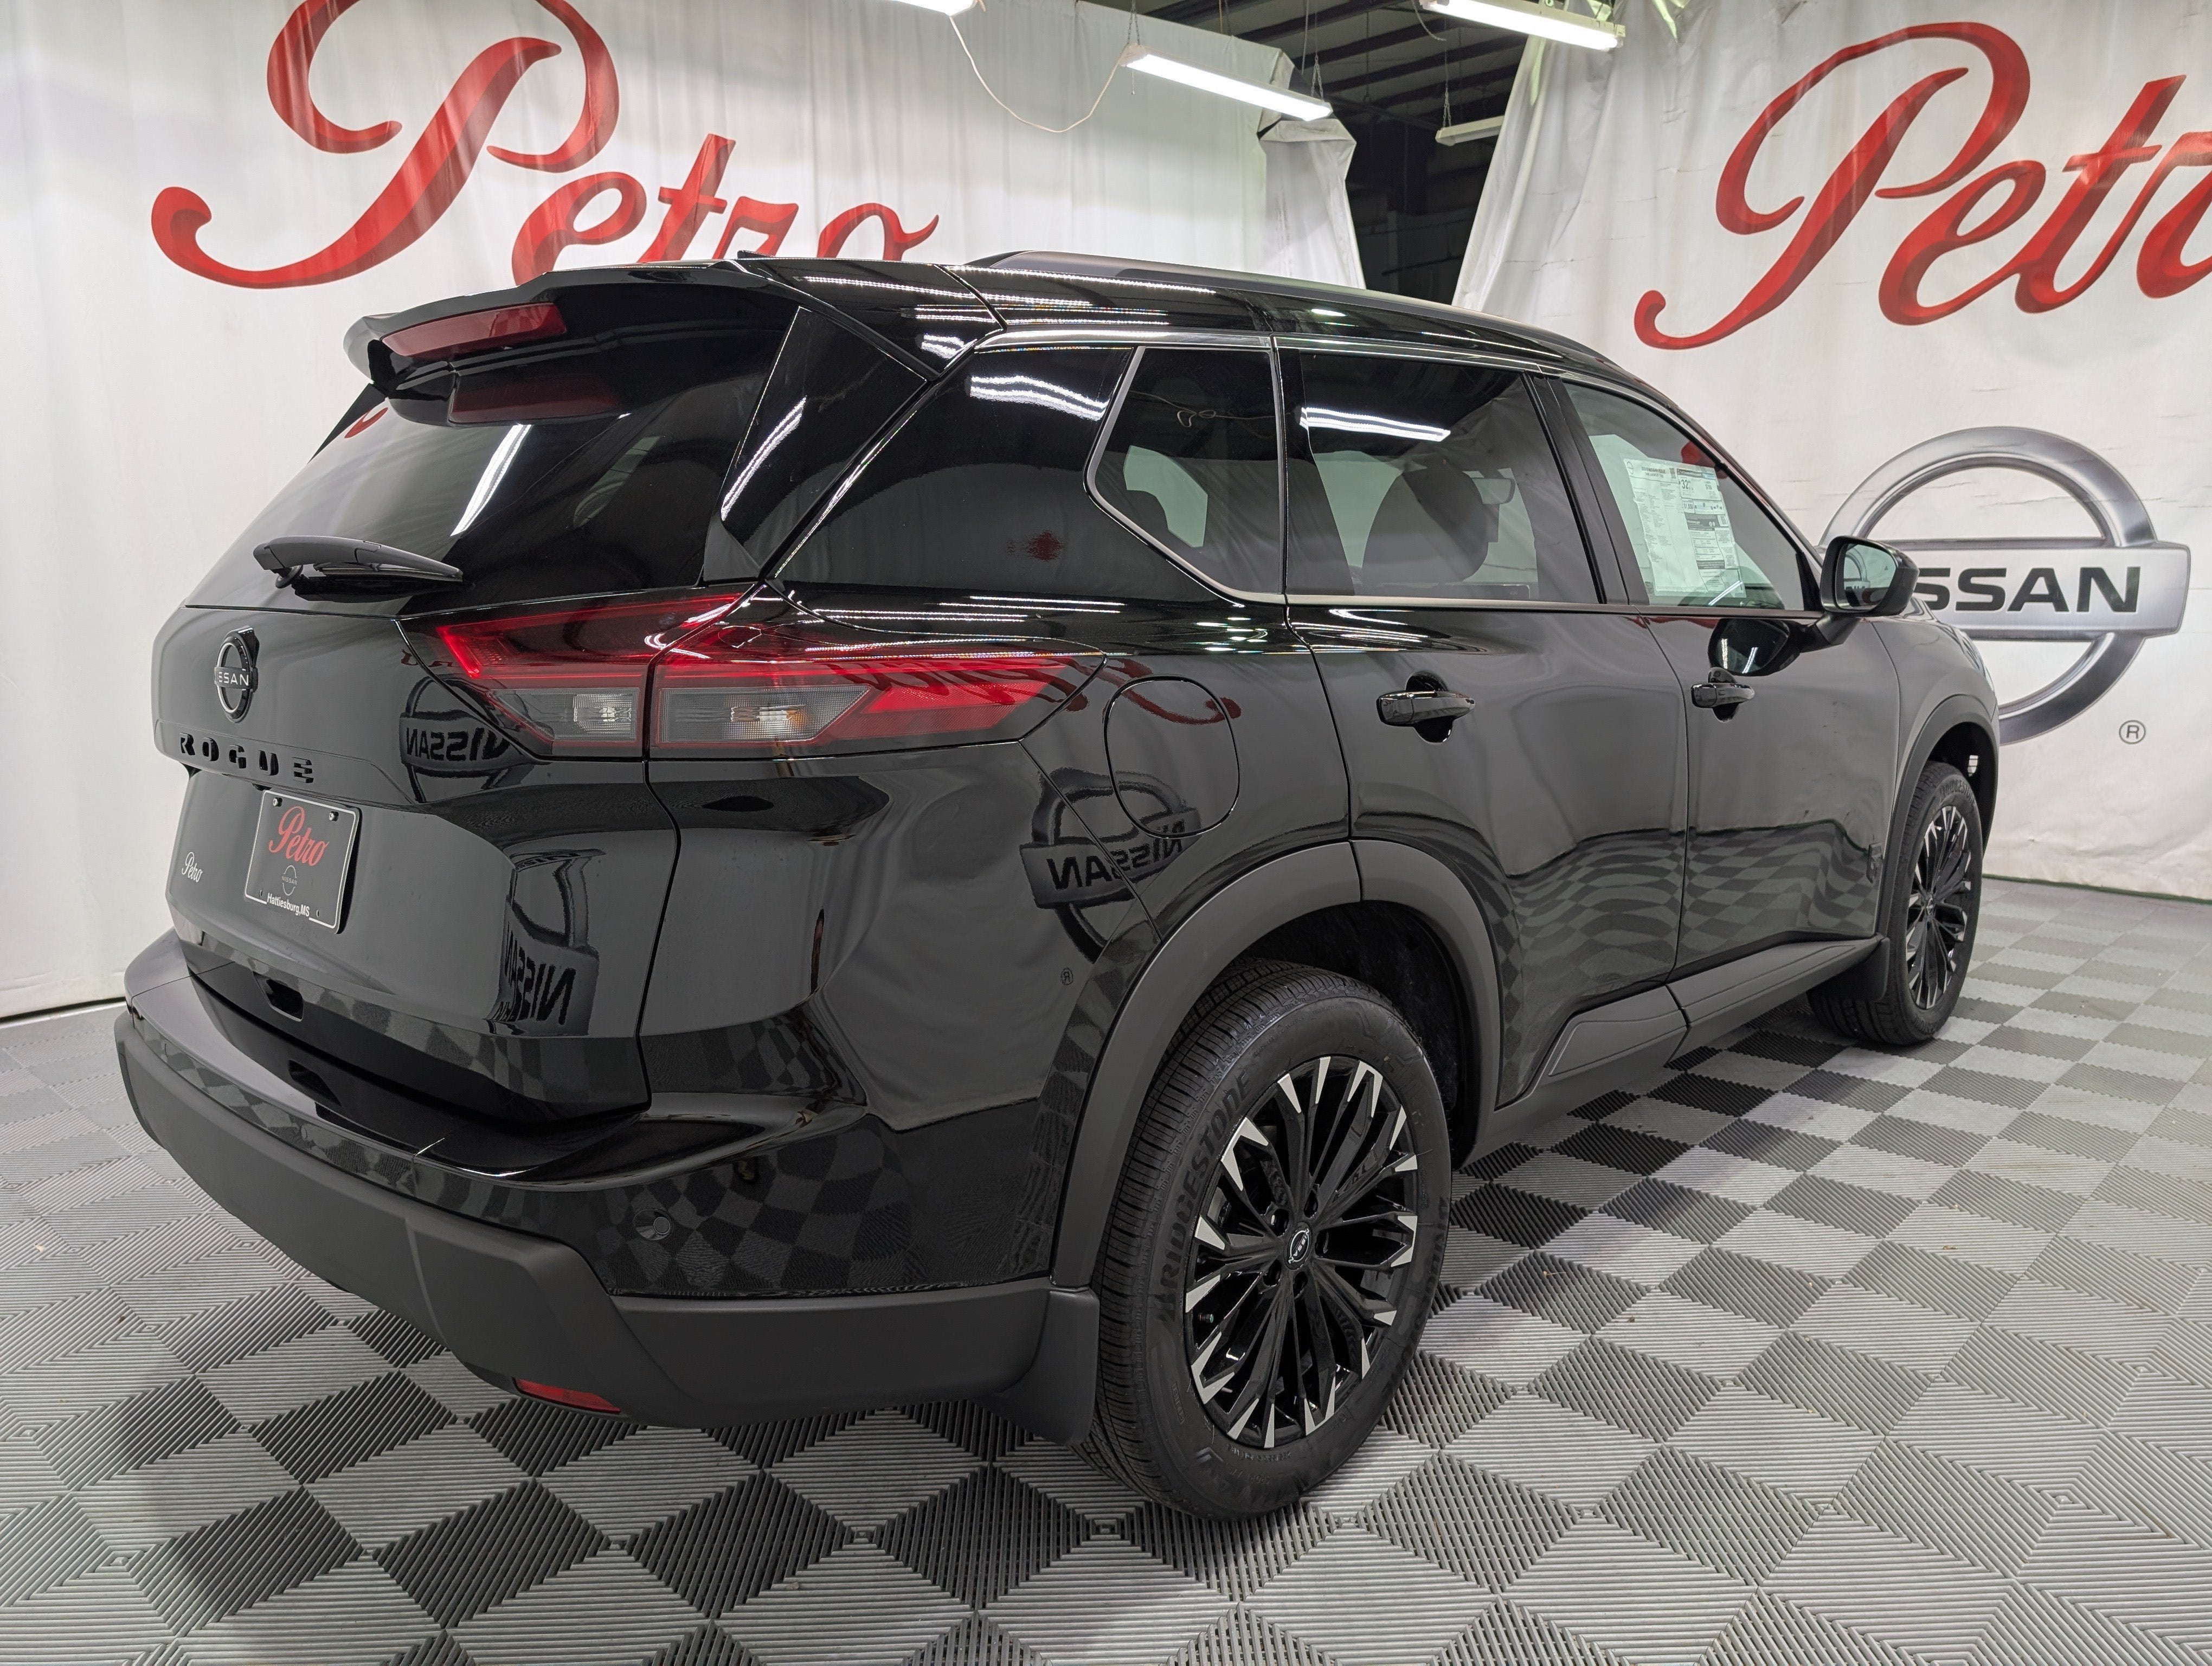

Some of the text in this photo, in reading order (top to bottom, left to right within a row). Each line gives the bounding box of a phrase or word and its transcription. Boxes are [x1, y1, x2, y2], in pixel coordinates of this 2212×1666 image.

[1917, 566, 2141, 613] SSAN
[218, 671, 249, 686] SSAN
[179, 732, 314, 784] ROGUE
[268, 805, 330, 867] Petro
[181, 851, 204, 883] Petro
[281, 875, 298, 886] NISSAN
